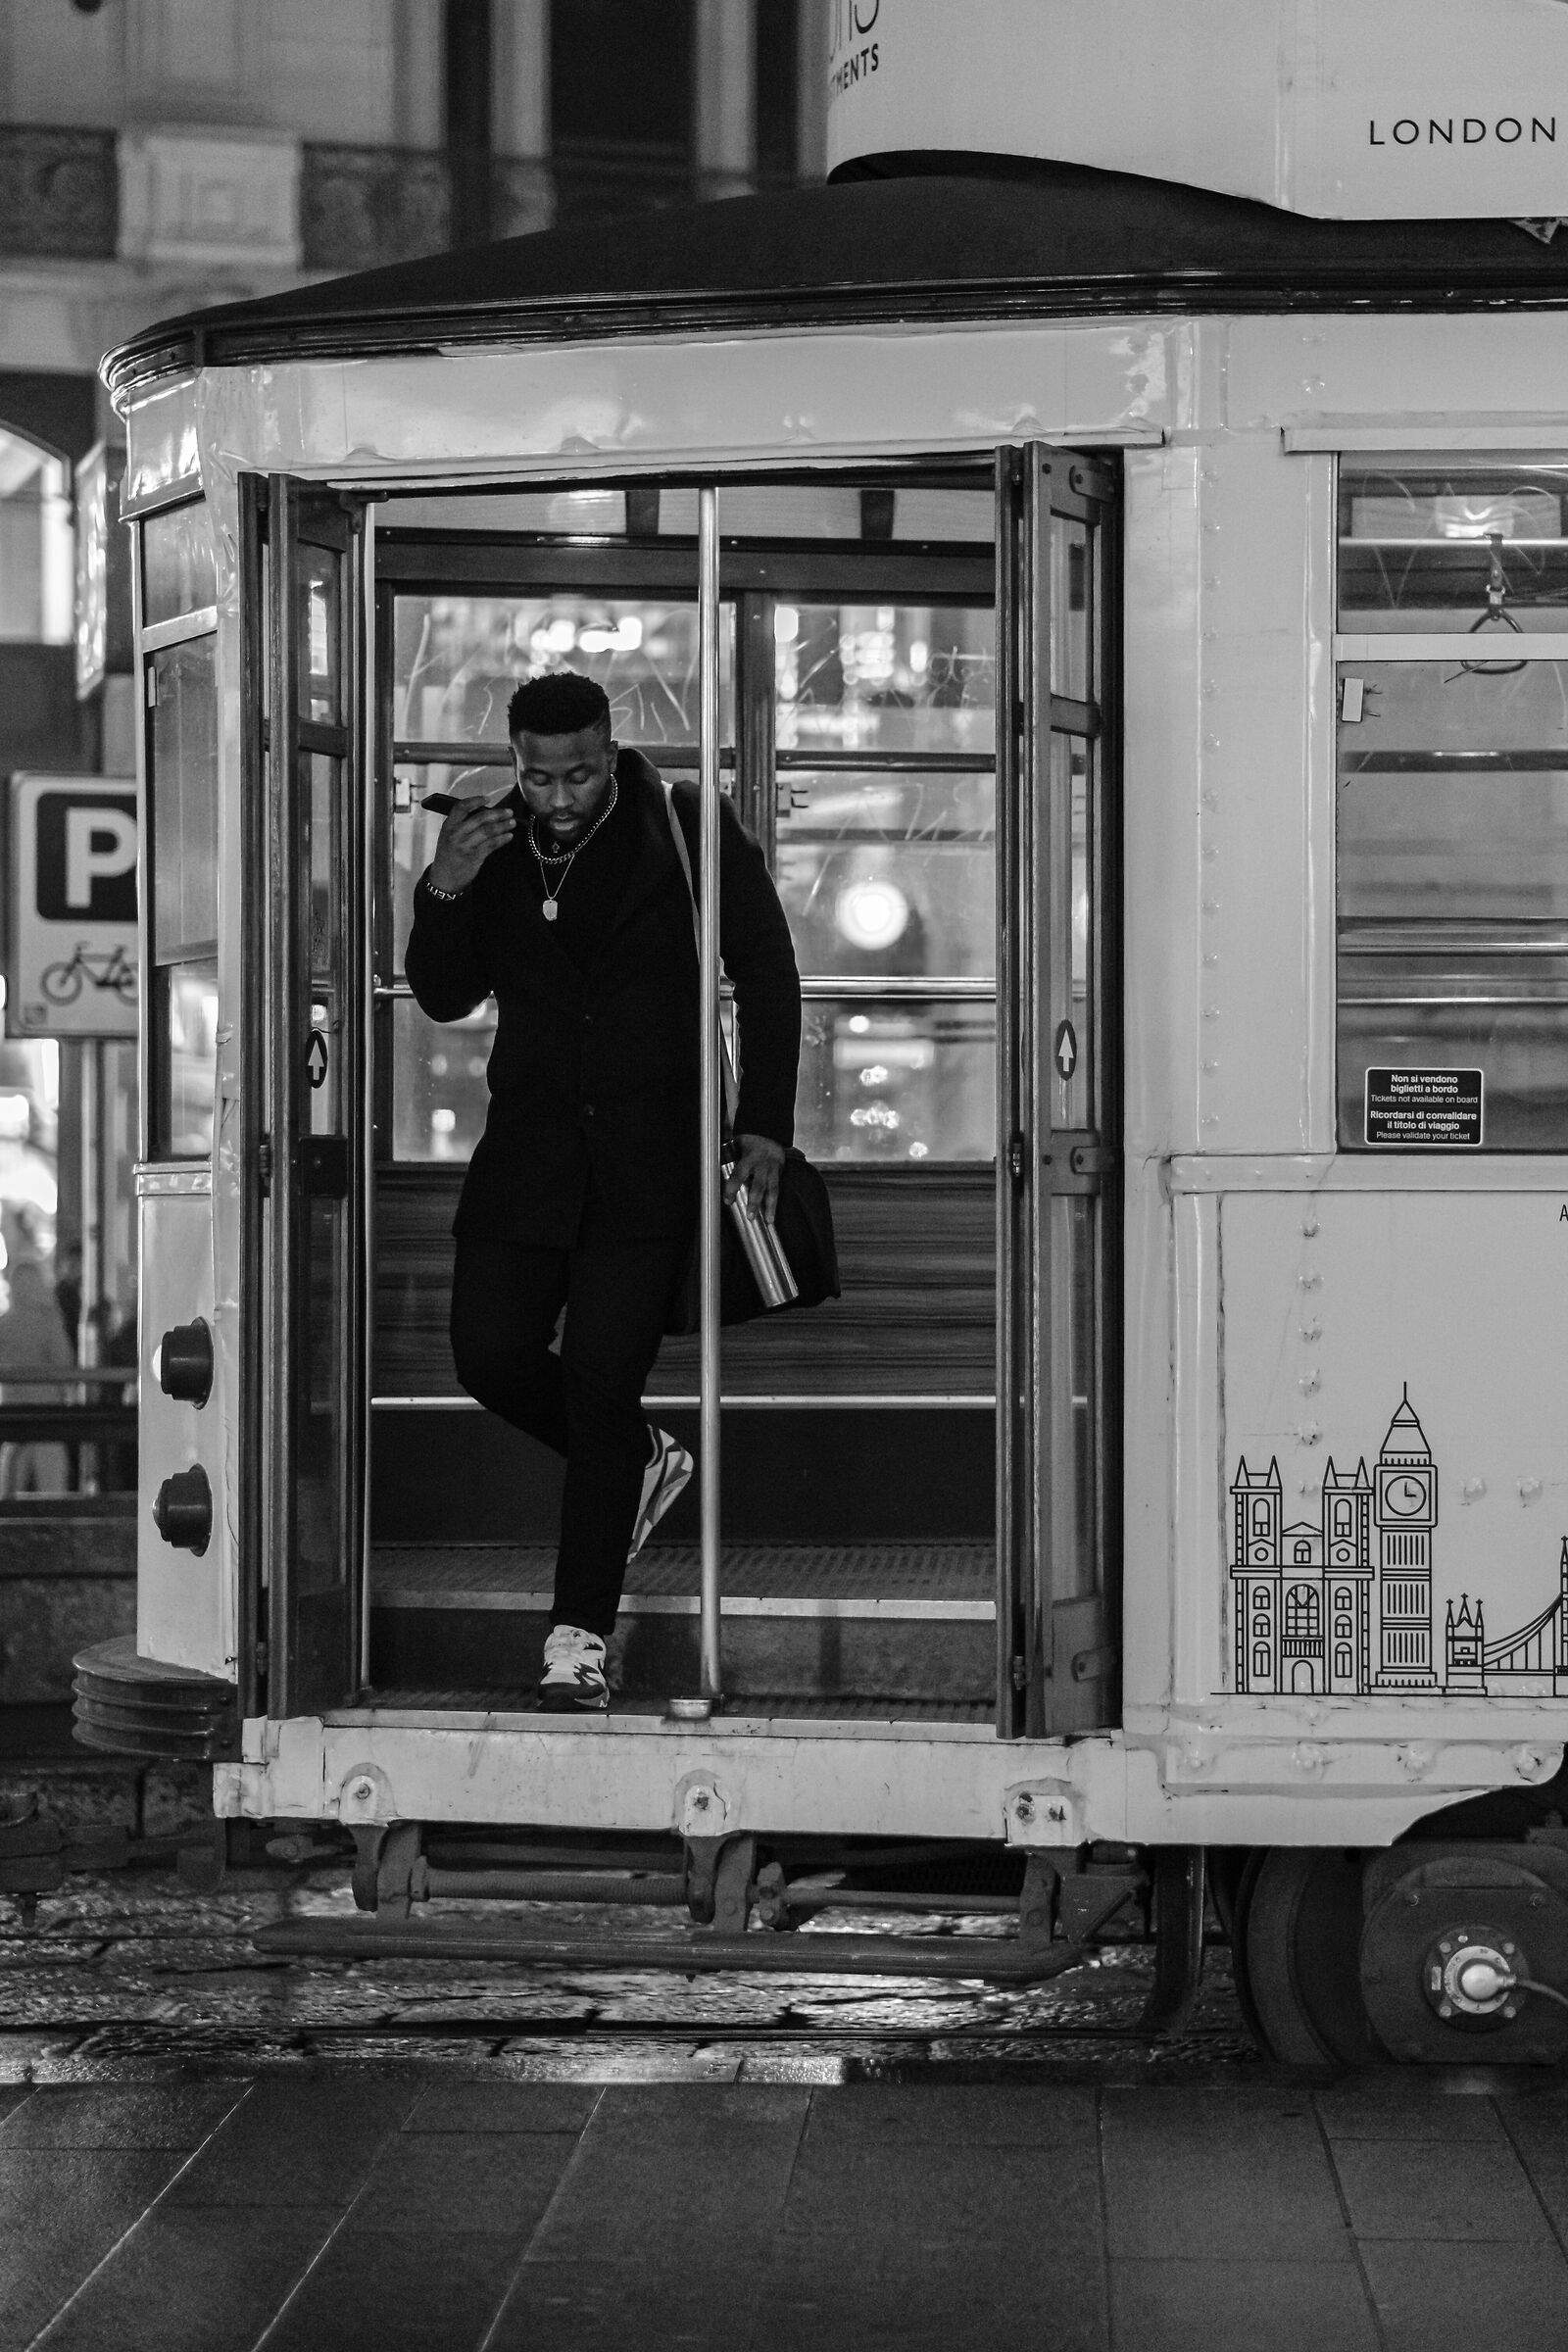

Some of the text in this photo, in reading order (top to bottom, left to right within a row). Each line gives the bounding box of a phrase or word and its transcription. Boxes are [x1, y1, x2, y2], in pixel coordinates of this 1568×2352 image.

[1370, 117, 1555, 145] LONDON
[65, 806, 138, 908] P
[1391, 1074, 1458, 1084] Non si vendono
[1391, 1085, 1424, 1094] biglietti
[1432, 1085, 1458, 1094] bordo
[1411, 1095, 1444, 1103] available
[1370, 1110, 1415, 1119] Ricordarsi
[1426, 1111, 1477, 1120] convalidare
[1387, 1120, 1393, 1129] il
[1418, 1121, 1427, 1130] di
[1428, 1122, 1460, 1131] viaggio
[1402, 1131, 1431, 1140] validate
